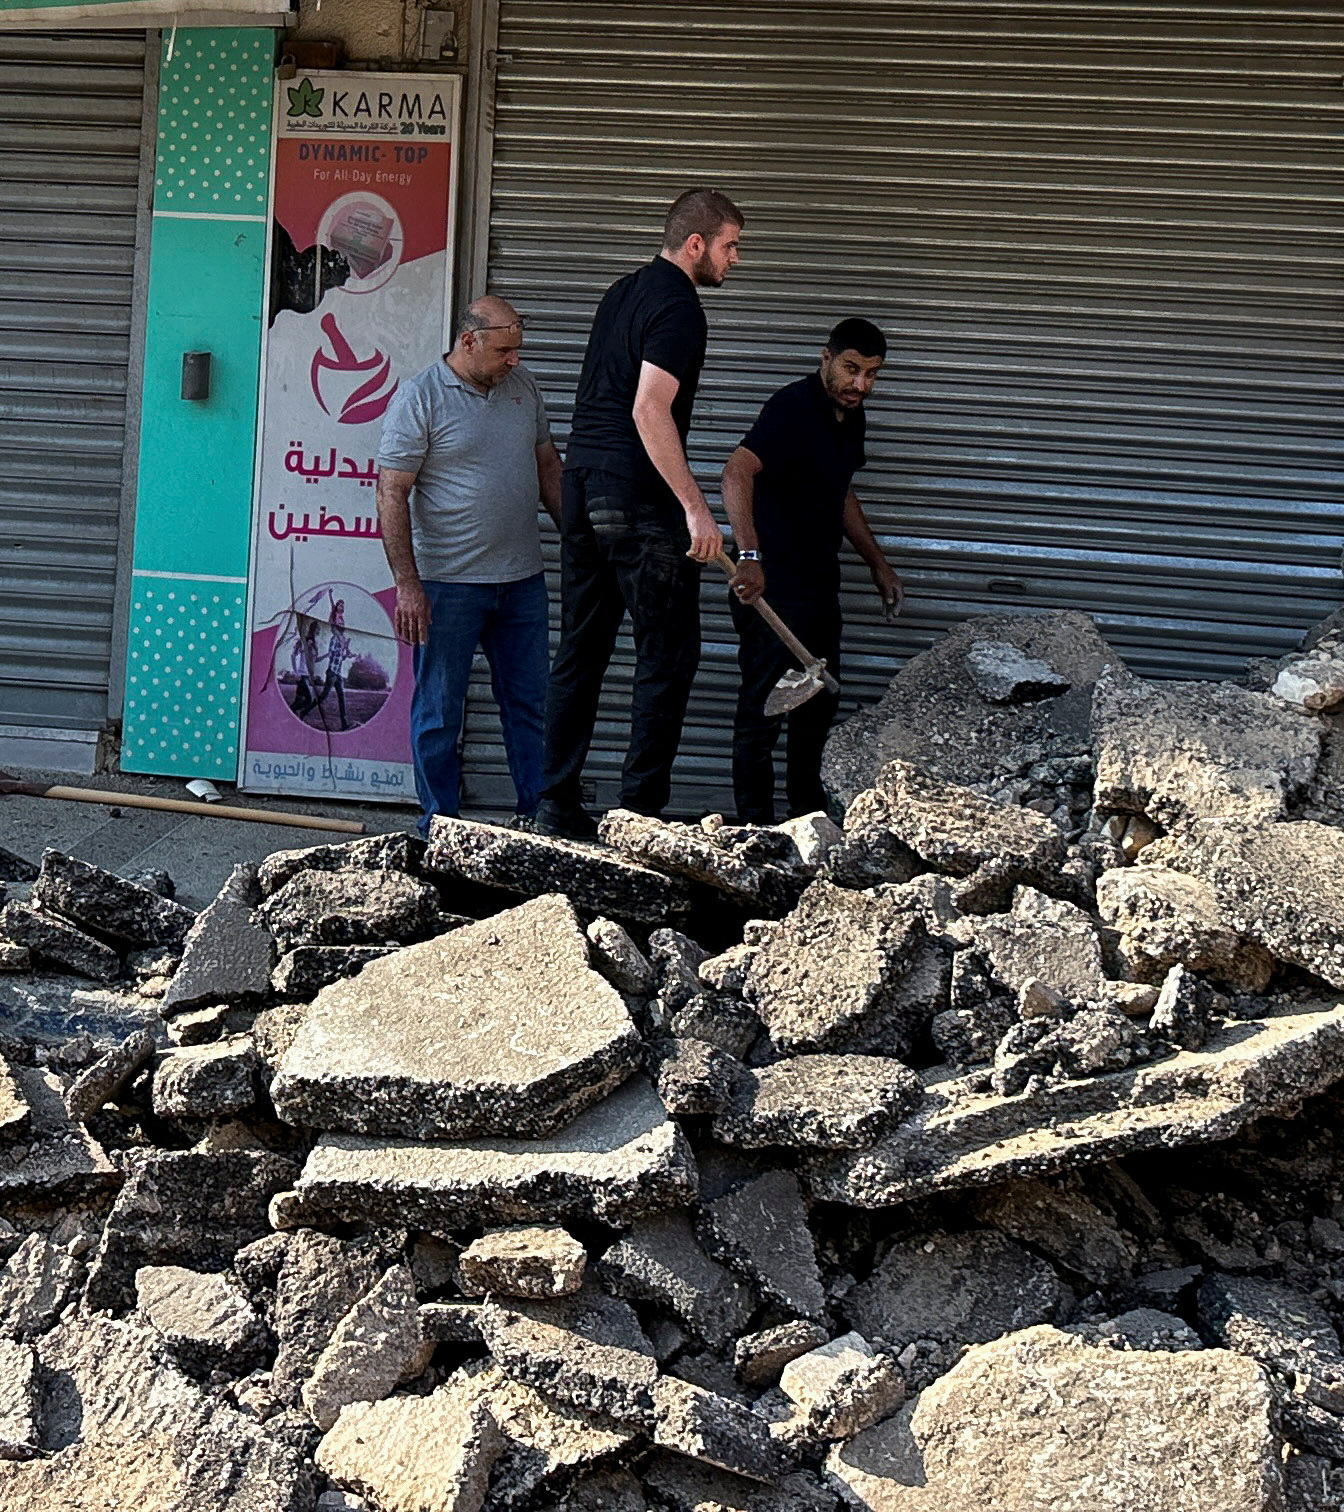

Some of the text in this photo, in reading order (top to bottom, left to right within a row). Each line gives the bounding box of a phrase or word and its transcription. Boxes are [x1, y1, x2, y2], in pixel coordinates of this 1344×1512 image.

[332, 91, 447, 120] KARMA
[400, 122, 446, 135] 20 Years
[394, 146, 429, 163] TOP
[313, 168, 330, 180] For
[375, 170, 412, 185] Energy
[284, 440, 380, 487] يدلية
[268, 503, 383, 543] سطين
[253, 759, 315, 782] والحيوية
